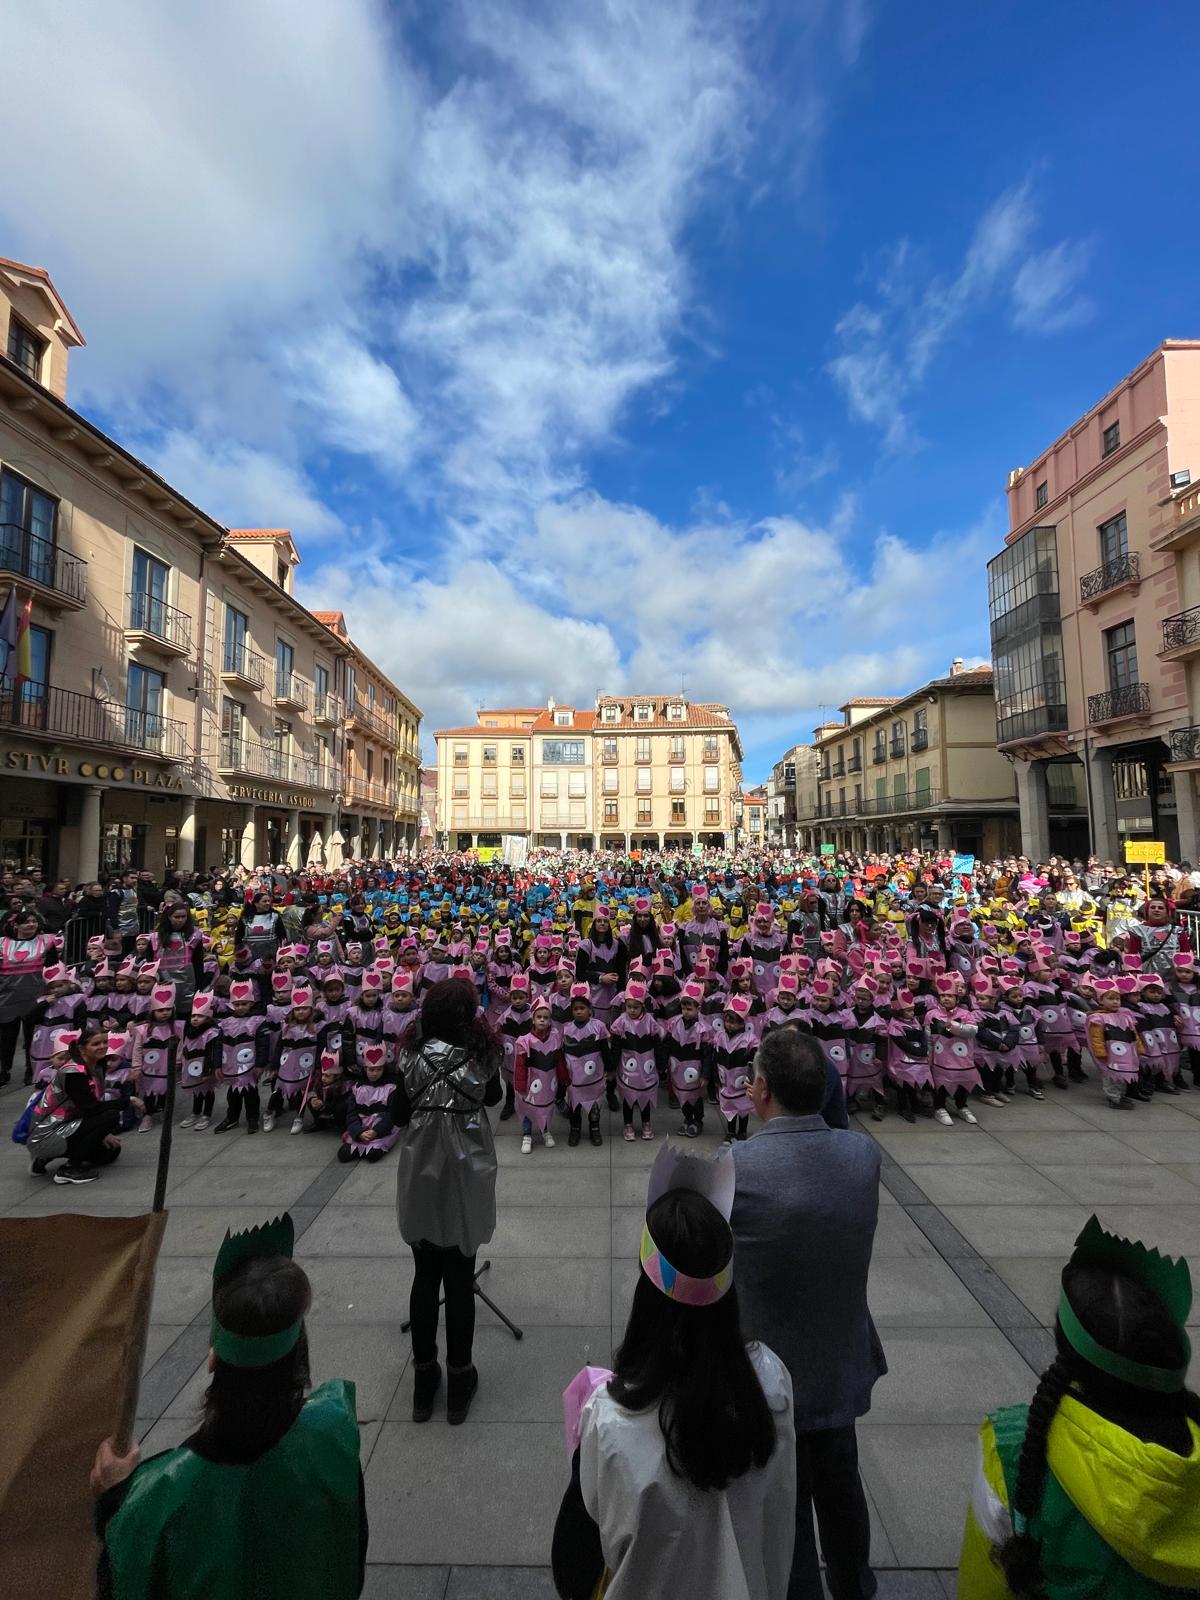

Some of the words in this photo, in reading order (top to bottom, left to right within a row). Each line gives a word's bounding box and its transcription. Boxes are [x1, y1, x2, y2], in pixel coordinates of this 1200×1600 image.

[0, 751, 71, 775] STVR
[133, 768, 183, 790] PLAZA
[227, 784, 283, 804] CERVECERIA
